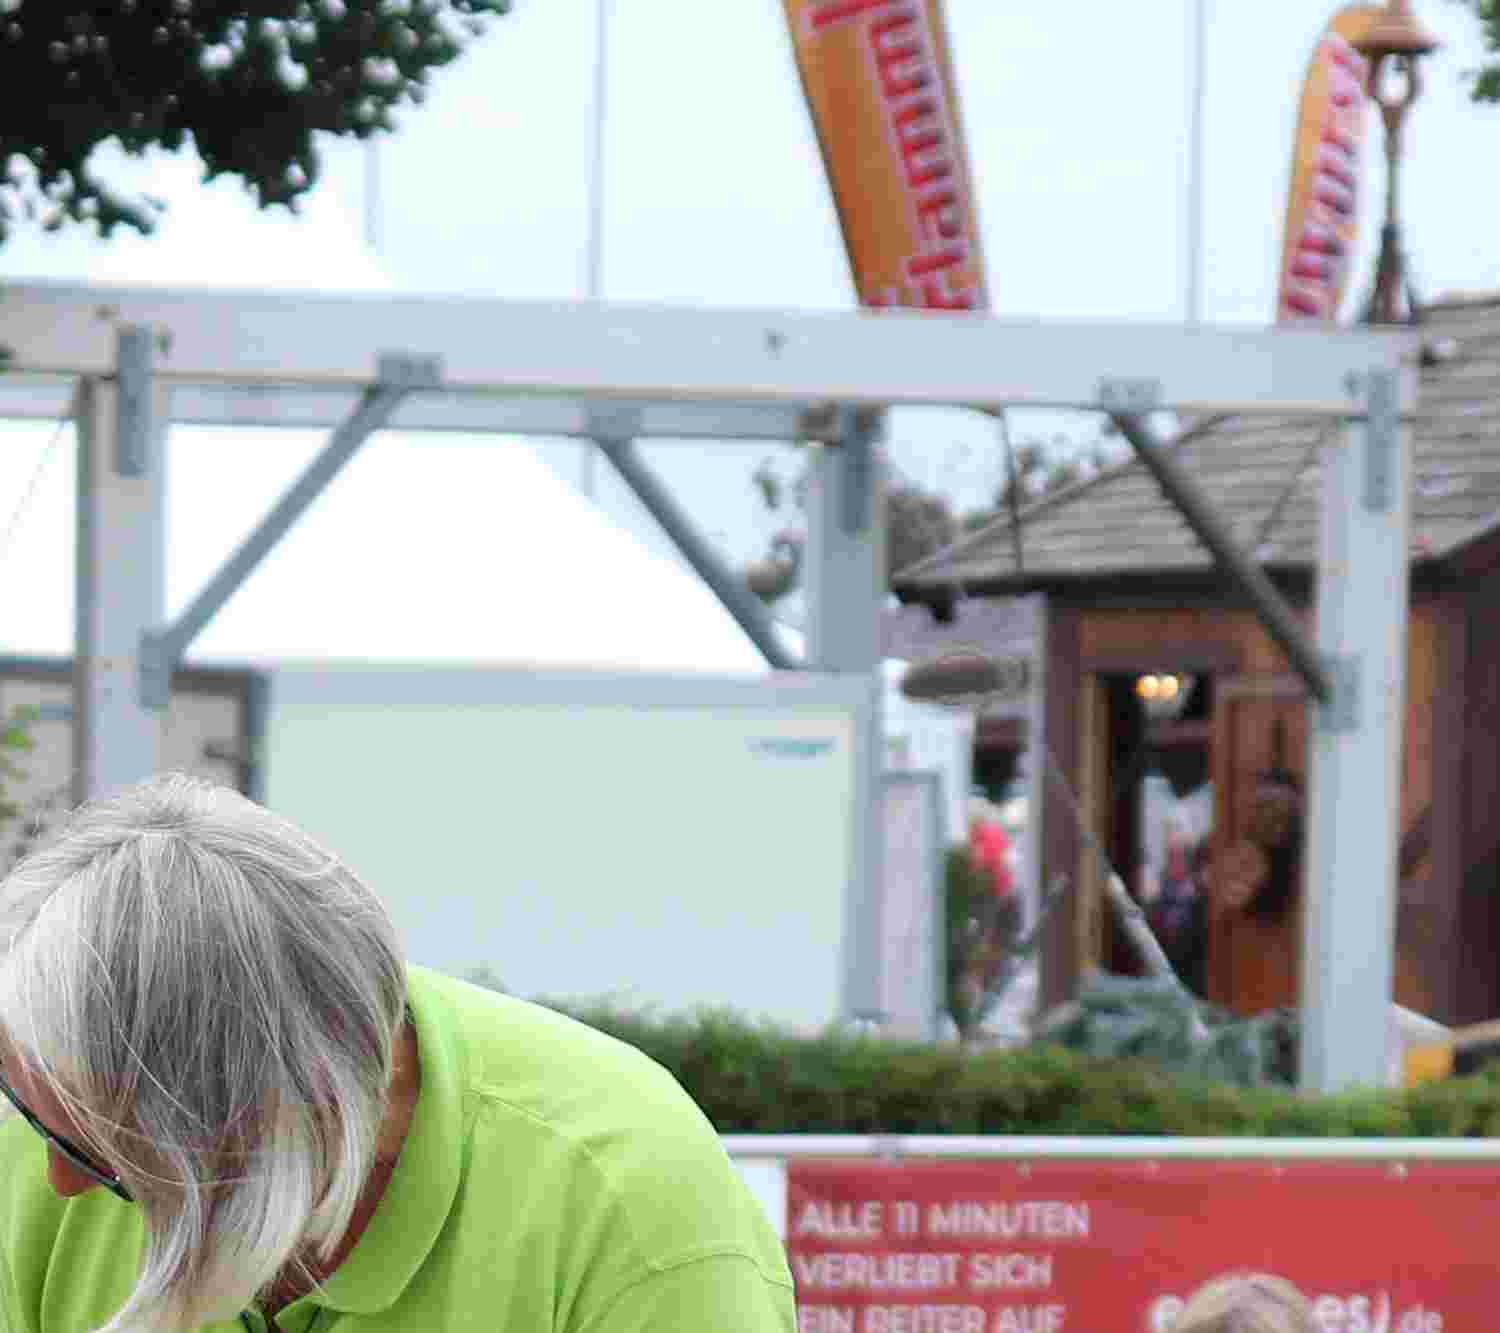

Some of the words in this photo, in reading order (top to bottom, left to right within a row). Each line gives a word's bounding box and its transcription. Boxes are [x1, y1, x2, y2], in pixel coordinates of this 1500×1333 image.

[799, 1200, 883, 1234] ALLE
[928, 1200, 1090, 1234] MINUTEN
[798, 1254, 957, 1288] VERLIEBT
[969, 1254, 1053, 1287] SICH
